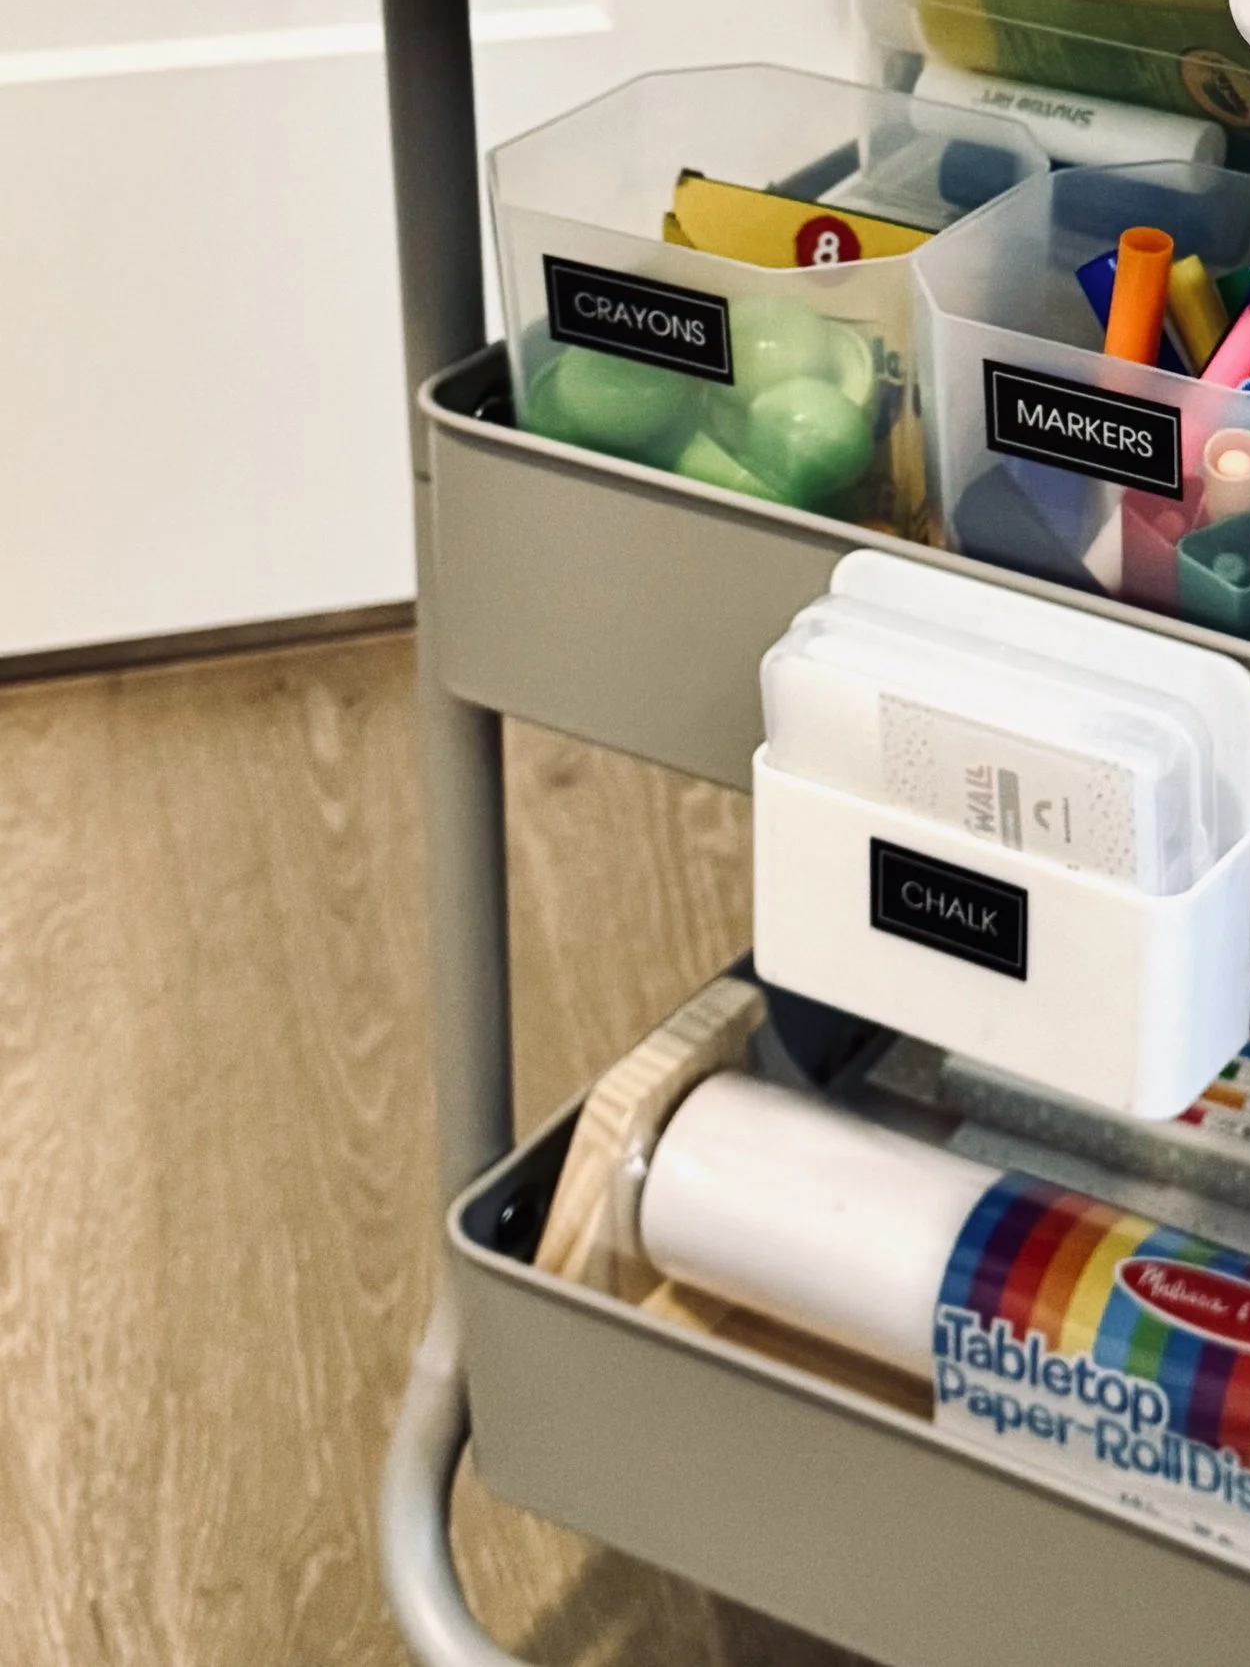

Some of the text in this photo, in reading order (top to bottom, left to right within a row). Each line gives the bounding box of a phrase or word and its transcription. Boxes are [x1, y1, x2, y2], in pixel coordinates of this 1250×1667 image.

[813, 231, 840, 266] 8
[574, 291, 706, 347] CRAYONS
[1017, 398, 1154, 459] MARKERS
[900, 880, 999, 938] CHALK
[1137, 1263, 1229, 1315] Melissa
[942, 1310, 1165, 1435] Tabletop
